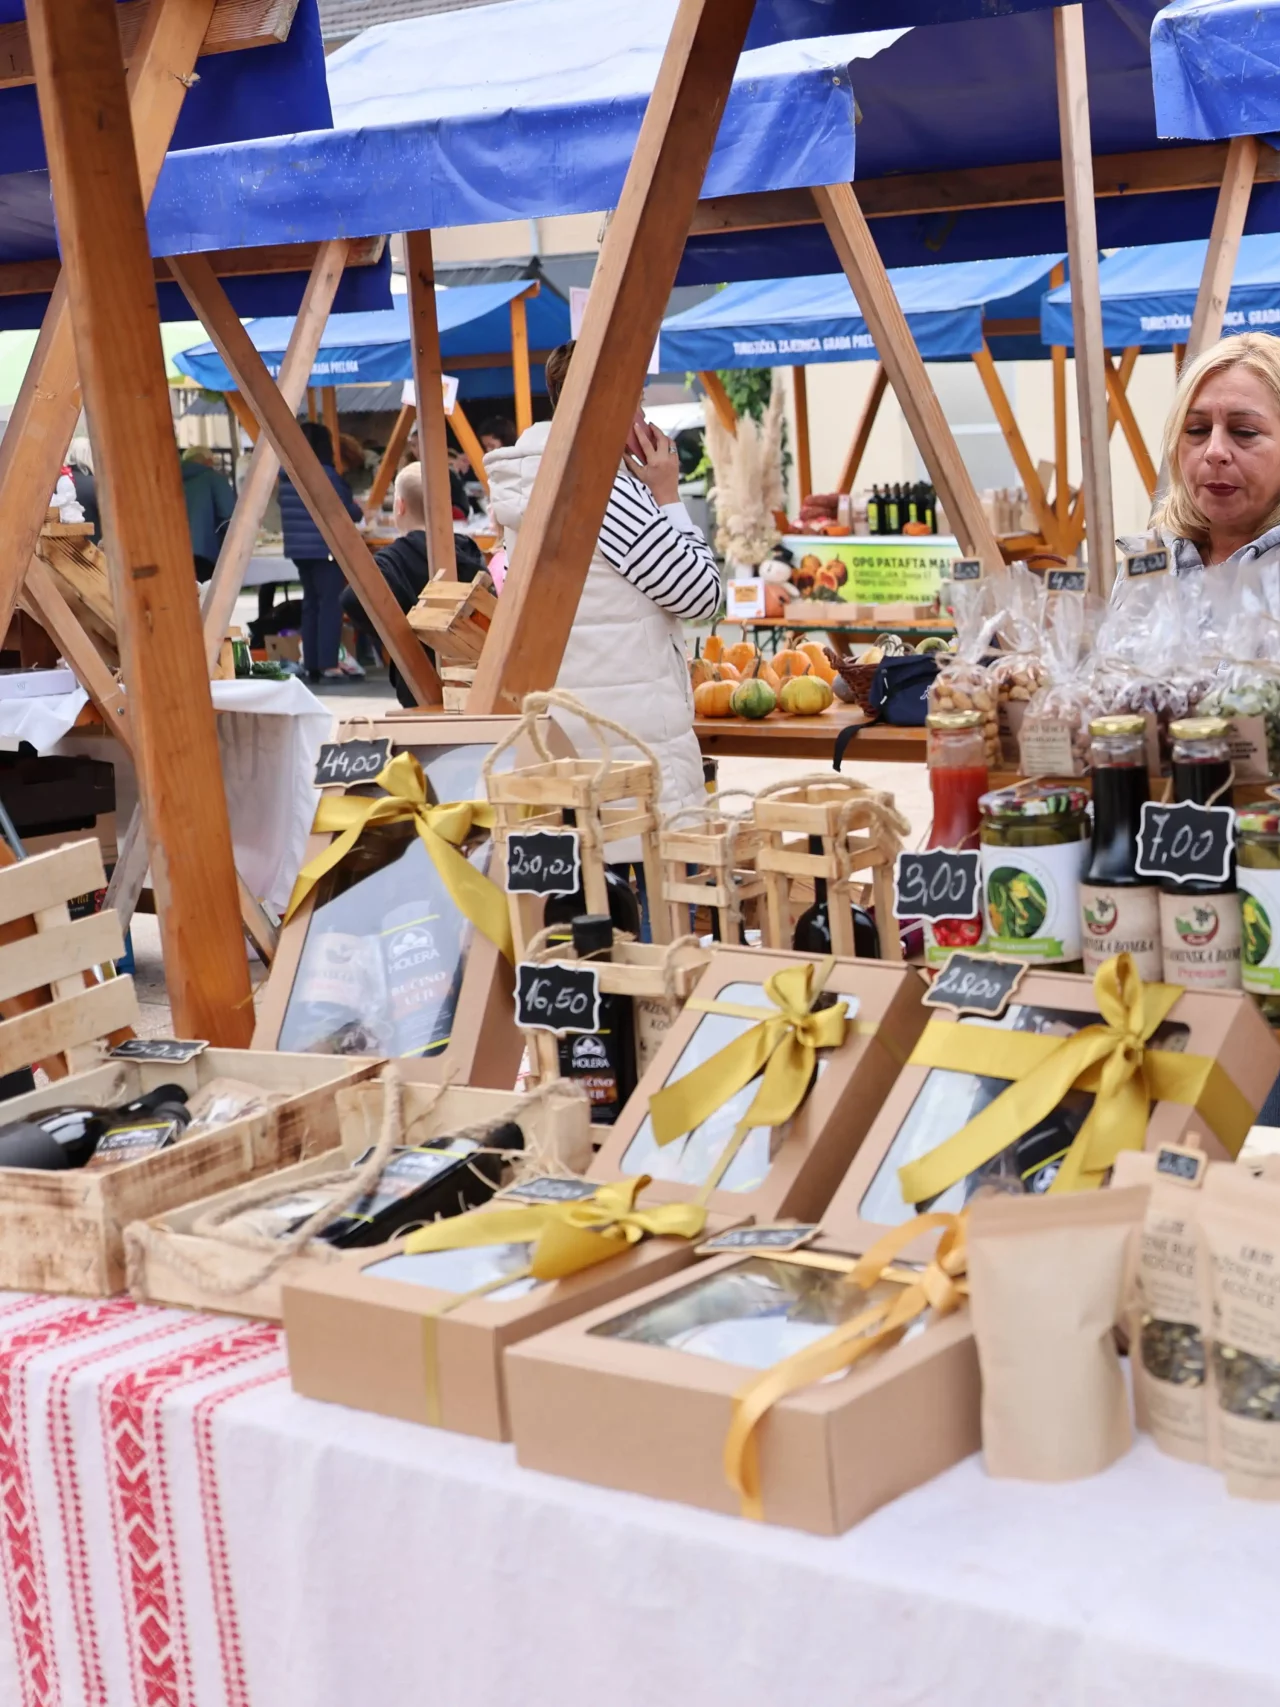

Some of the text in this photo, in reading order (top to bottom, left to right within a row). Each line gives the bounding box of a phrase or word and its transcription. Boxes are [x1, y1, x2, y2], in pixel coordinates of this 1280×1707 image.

[1139, 313, 1192, 331] TURISTIČKA
[733, 339, 777, 355] TURISTIČKA
[823, 335, 850, 351] GRADA
[852, 333, 875, 348] PREL
[852, 556, 875, 568] OPG
[322, 748, 381, 776] 44,00
[1151, 813, 1214, 864] 7,00
[900, 862, 968, 907] 3,00
[387, 948, 440, 974] HOLERA
[525, 978, 588, 1016] 16,50
[572, 1058, 610, 1069] HOLERA
